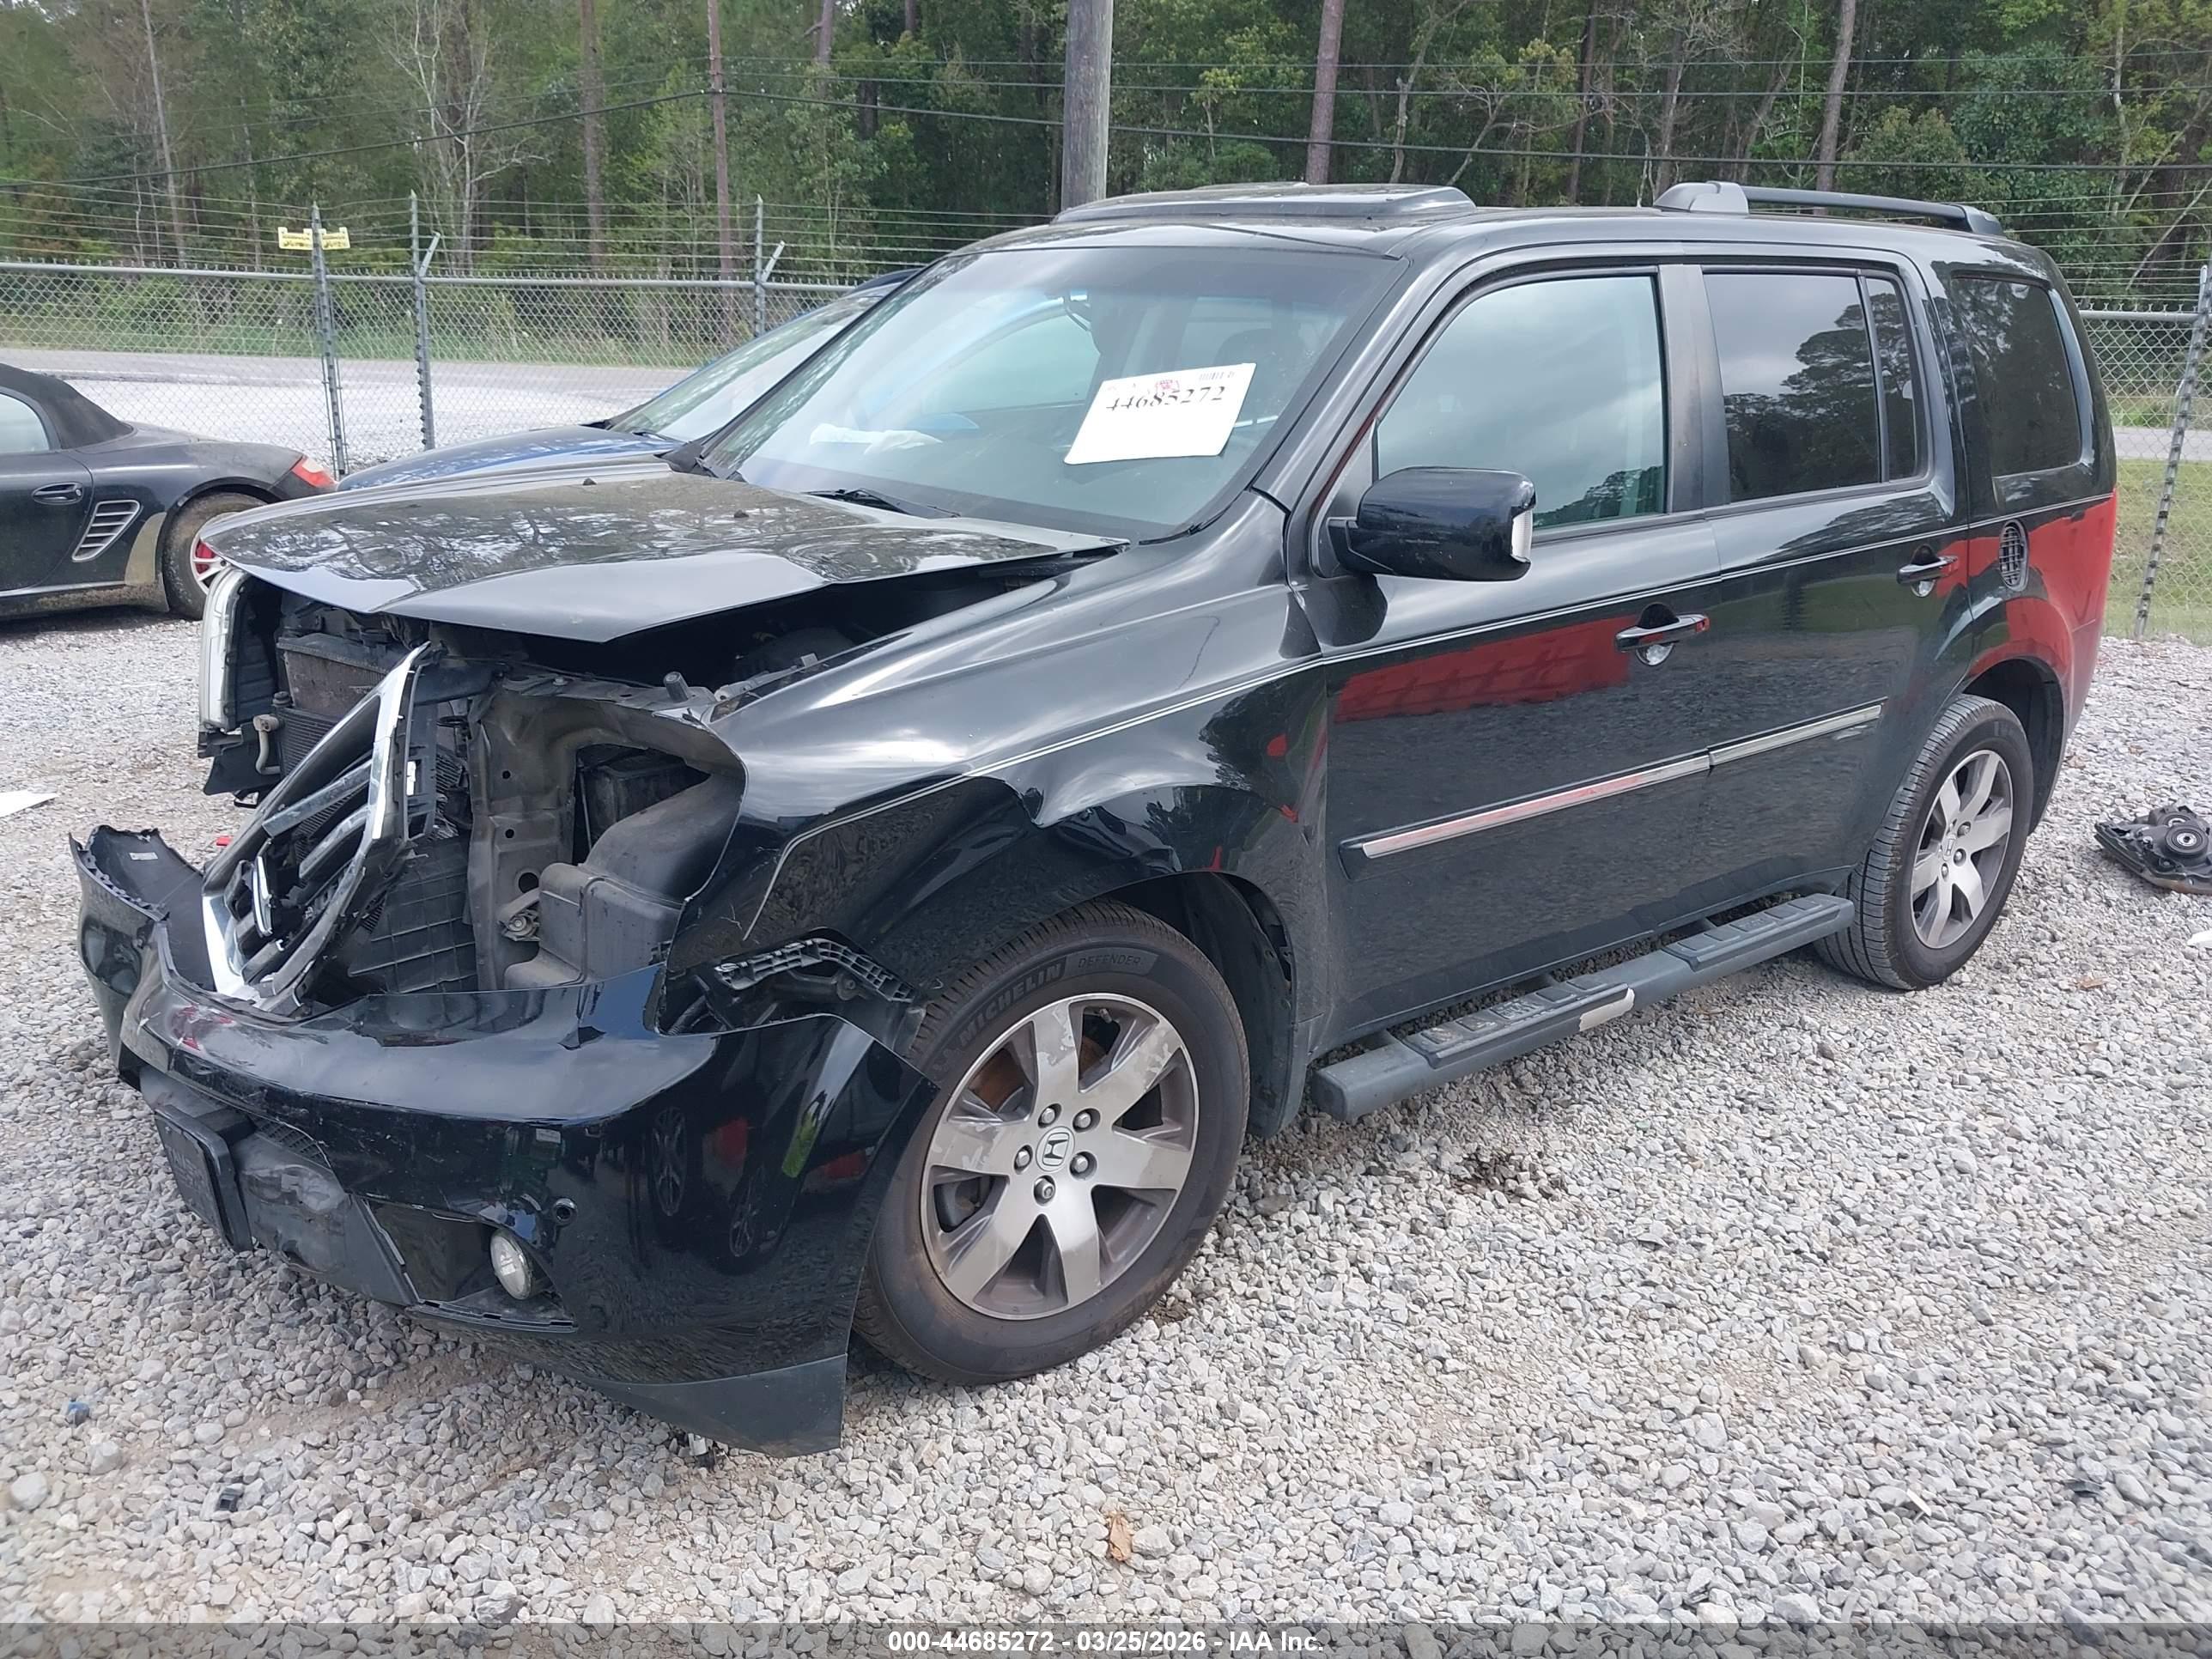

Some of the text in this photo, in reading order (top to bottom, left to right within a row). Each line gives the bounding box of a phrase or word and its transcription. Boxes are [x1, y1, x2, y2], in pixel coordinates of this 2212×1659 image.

[1106, 386, 1225, 410] 44685272
[959, 954, 1141, 1047] MICHELIN DEFENDER
